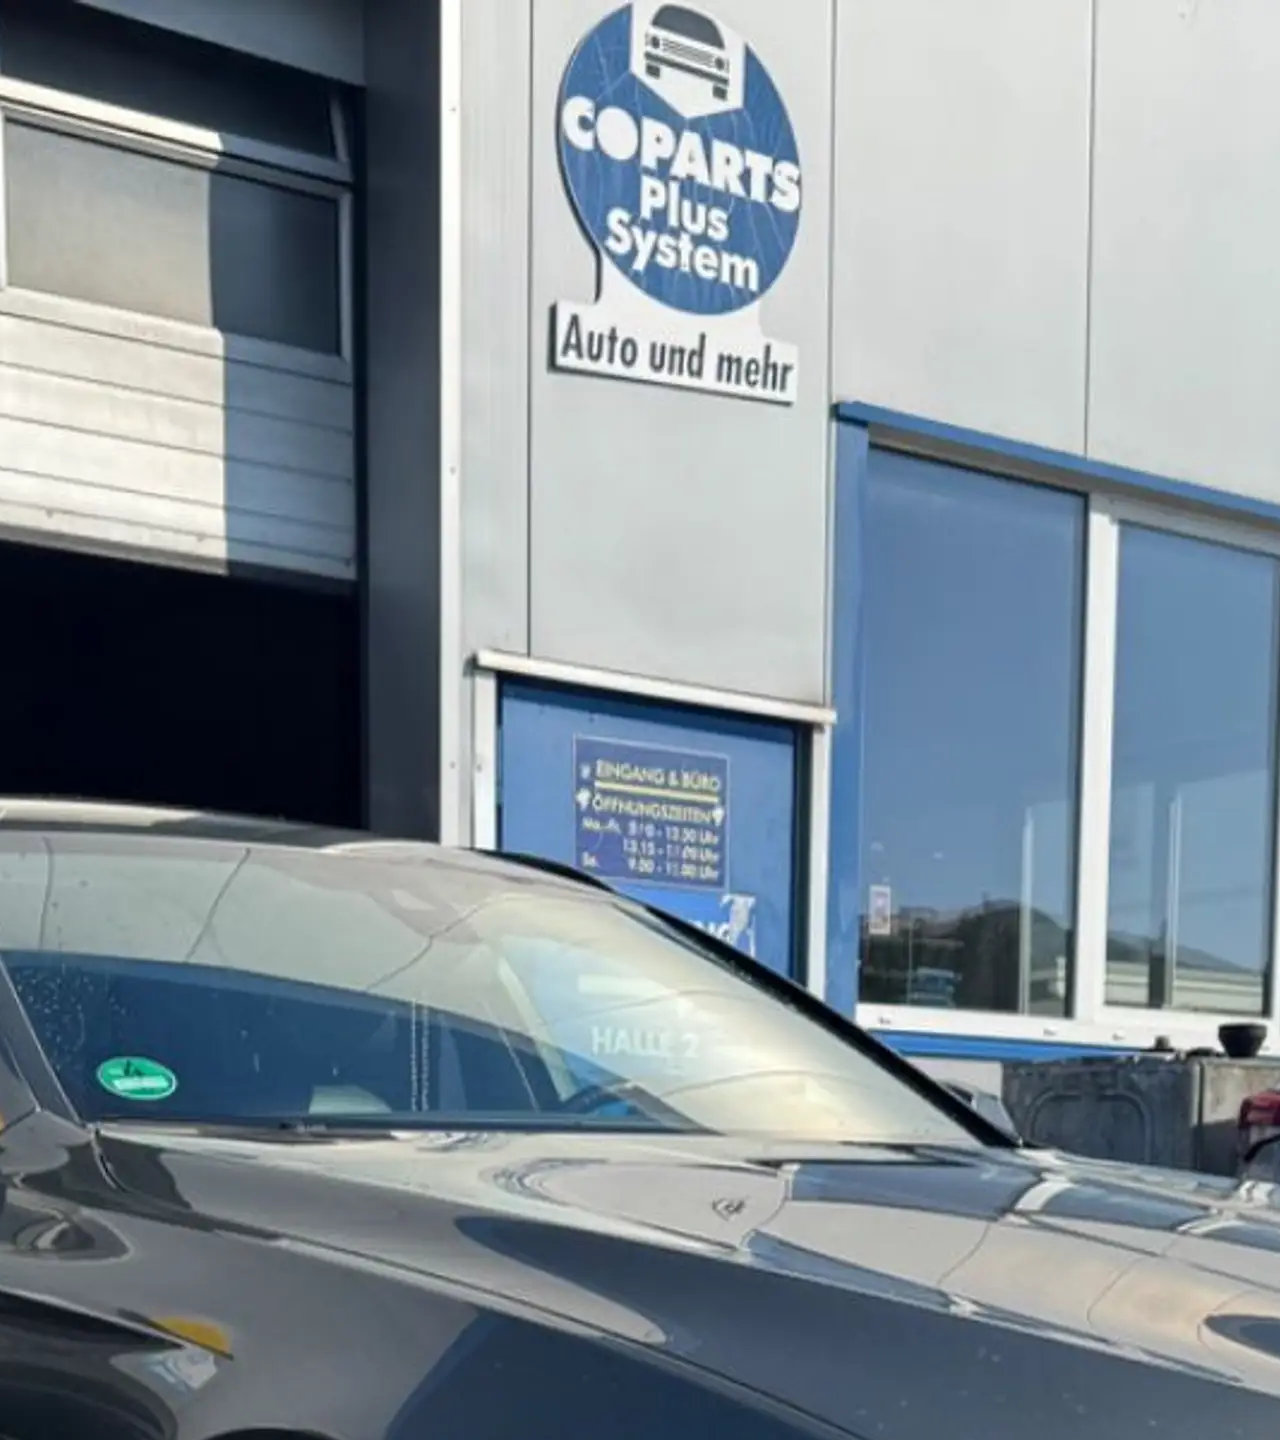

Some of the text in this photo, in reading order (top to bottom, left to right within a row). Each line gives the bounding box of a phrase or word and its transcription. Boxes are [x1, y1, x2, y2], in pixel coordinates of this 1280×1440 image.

[561, 95, 801, 213] COPARTS
[640, 175, 729, 241] Plus
[605, 206, 758, 292] System
[561, 313, 794, 394] Auto und mehr
[596, 759, 666, 785] EINGANG
[681, 768, 721, 792] BÜRO
[591, 1026, 700, 1058] HALLE 2
